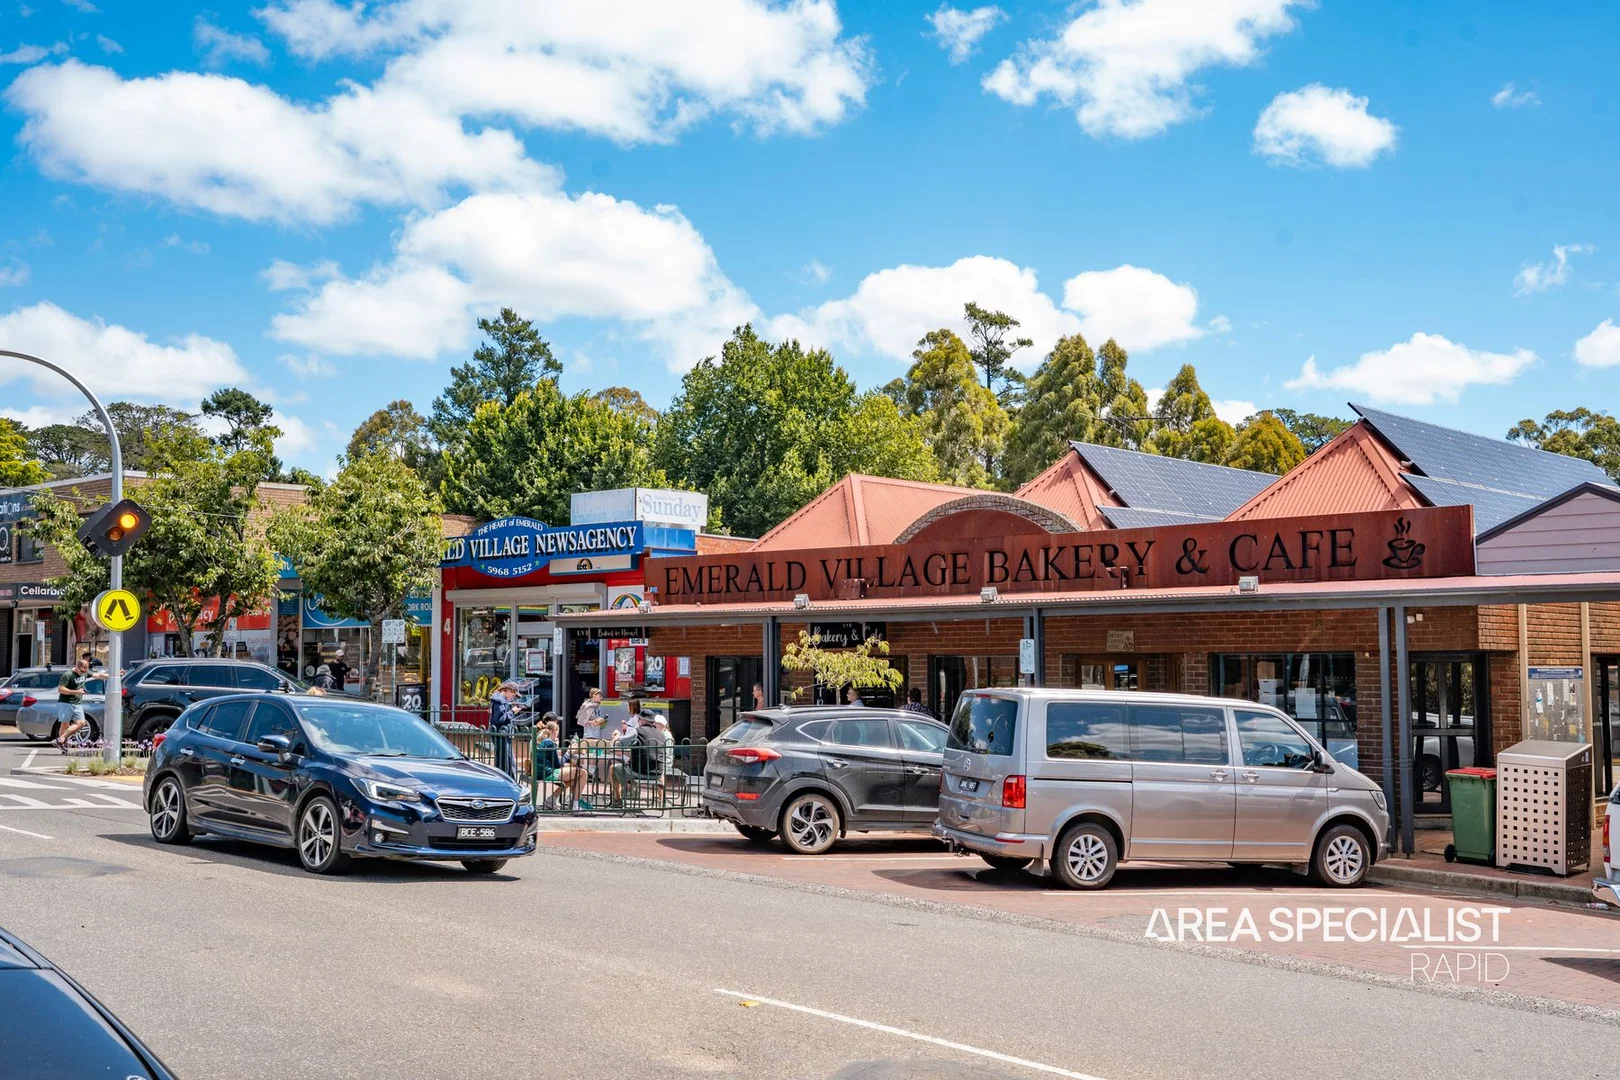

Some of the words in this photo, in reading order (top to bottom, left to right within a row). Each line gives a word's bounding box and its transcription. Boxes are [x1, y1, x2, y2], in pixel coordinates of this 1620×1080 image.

[642, 494, 702, 521] Sunday
[477, 526, 489, 536] THE
[489, 519, 507, 531] HEART
[509, 518, 515, 527] of
[515, 518, 543, 531] EMERALD
[470, 535, 529, 558] VILLAGE
[536, 526, 638, 553] NEWSAGENCY
[487, 565, 509, 576] 5968
[512, 563, 532, 575] 5152
[664, 561, 807, 596] EMERALD
[819, 552, 971, 590] VILLAGE
[986, 540, 1156, 582] BAKERY
[1175, 537, 1210, 575] &
[1228, 528, 1359, 572] CAFE
[443, 618, 451, 635] 4
[813, 626, 848, 647] Bakery
[851, 628, 859, 641] &
